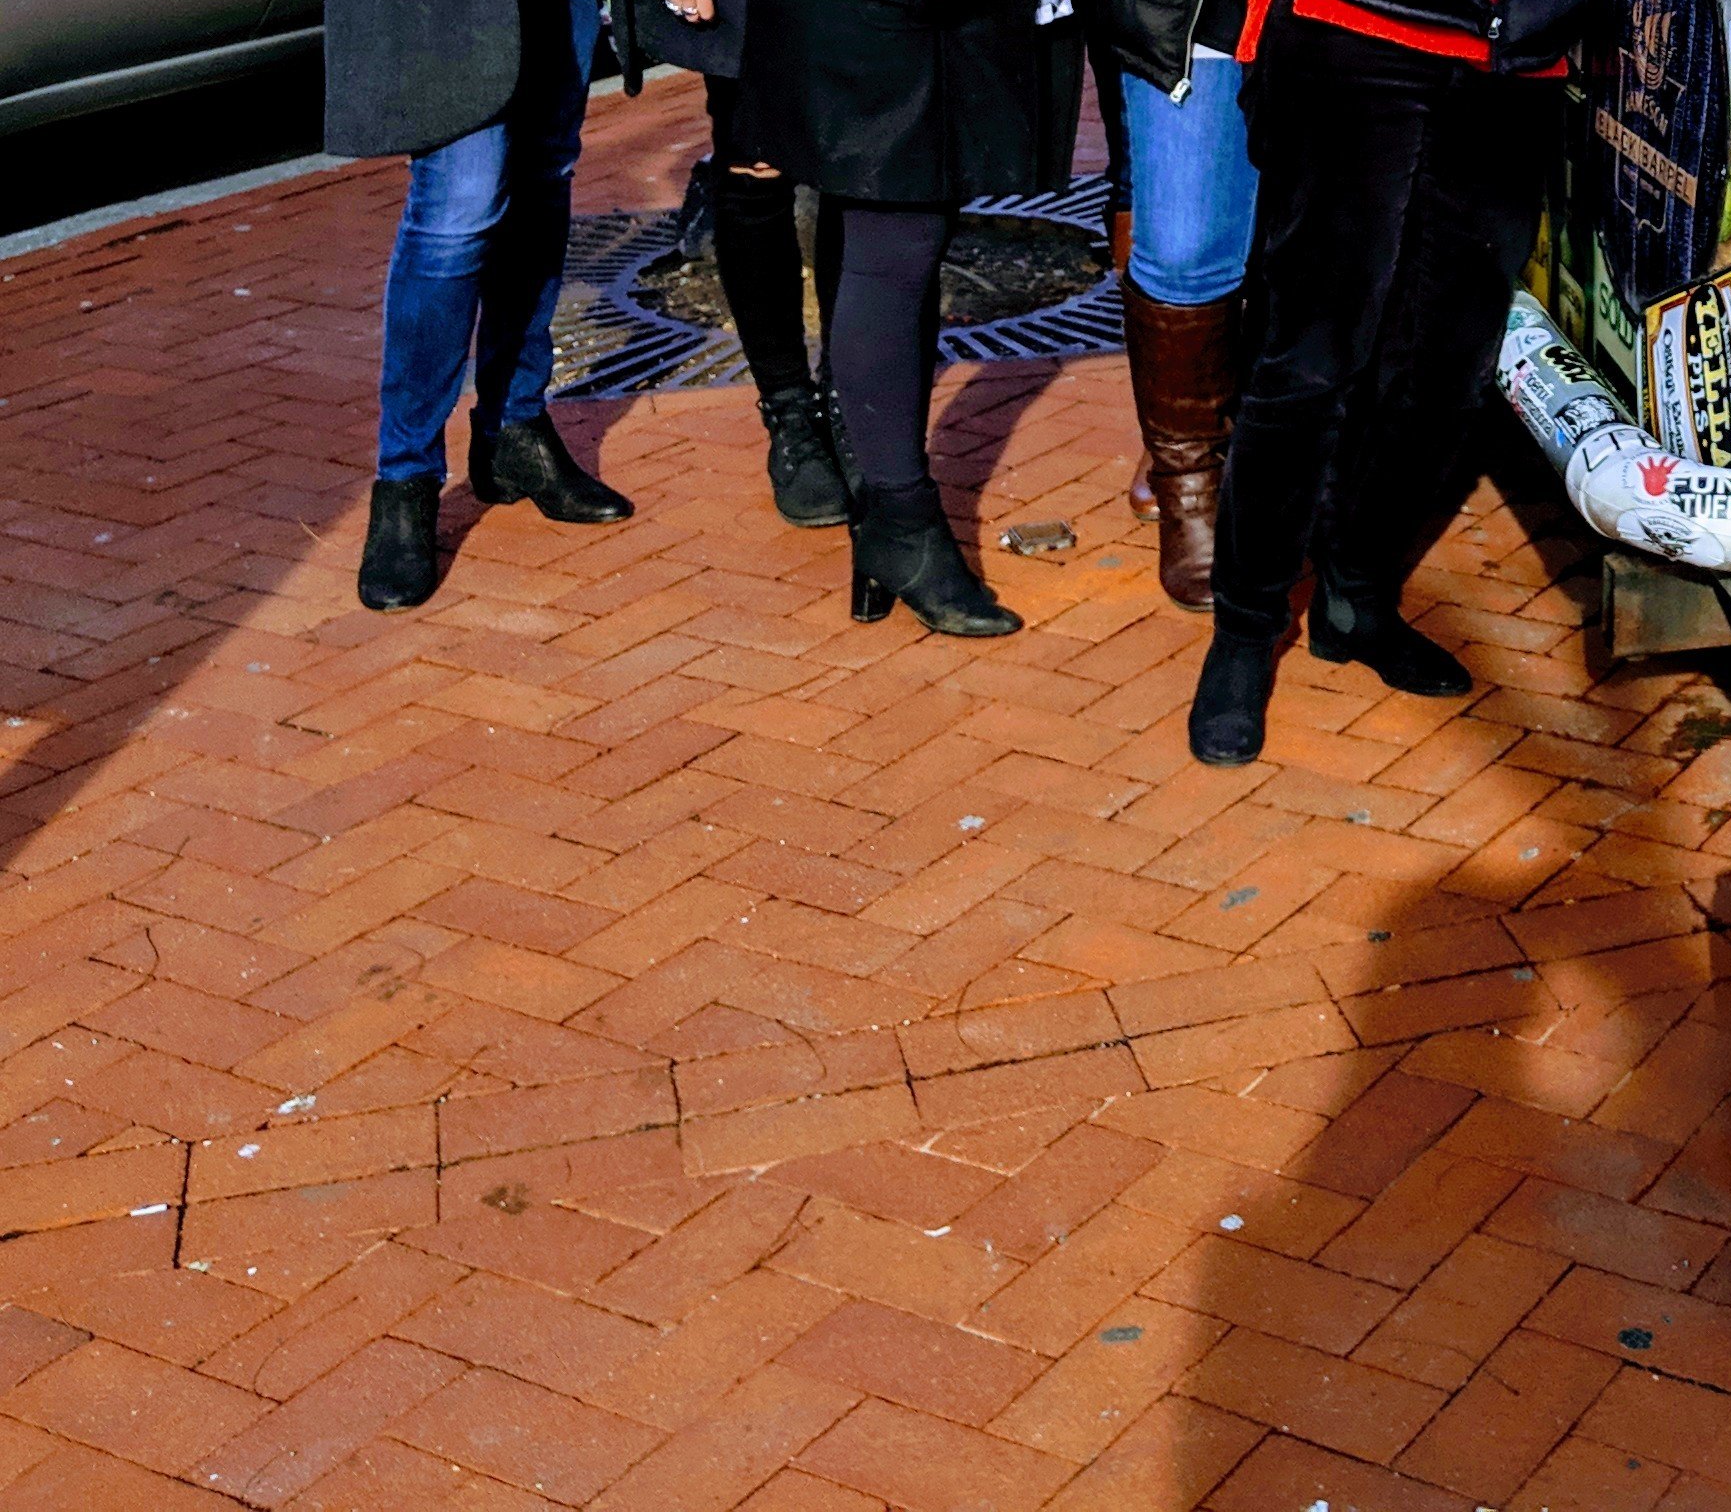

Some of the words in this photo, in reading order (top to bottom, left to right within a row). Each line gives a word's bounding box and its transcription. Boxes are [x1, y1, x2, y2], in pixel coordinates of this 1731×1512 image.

[1596, 109, 1640, 164] BLACK
[1640, 139, 1693, 202] BARREL
[1688, 353, 1710, 433] PILS
